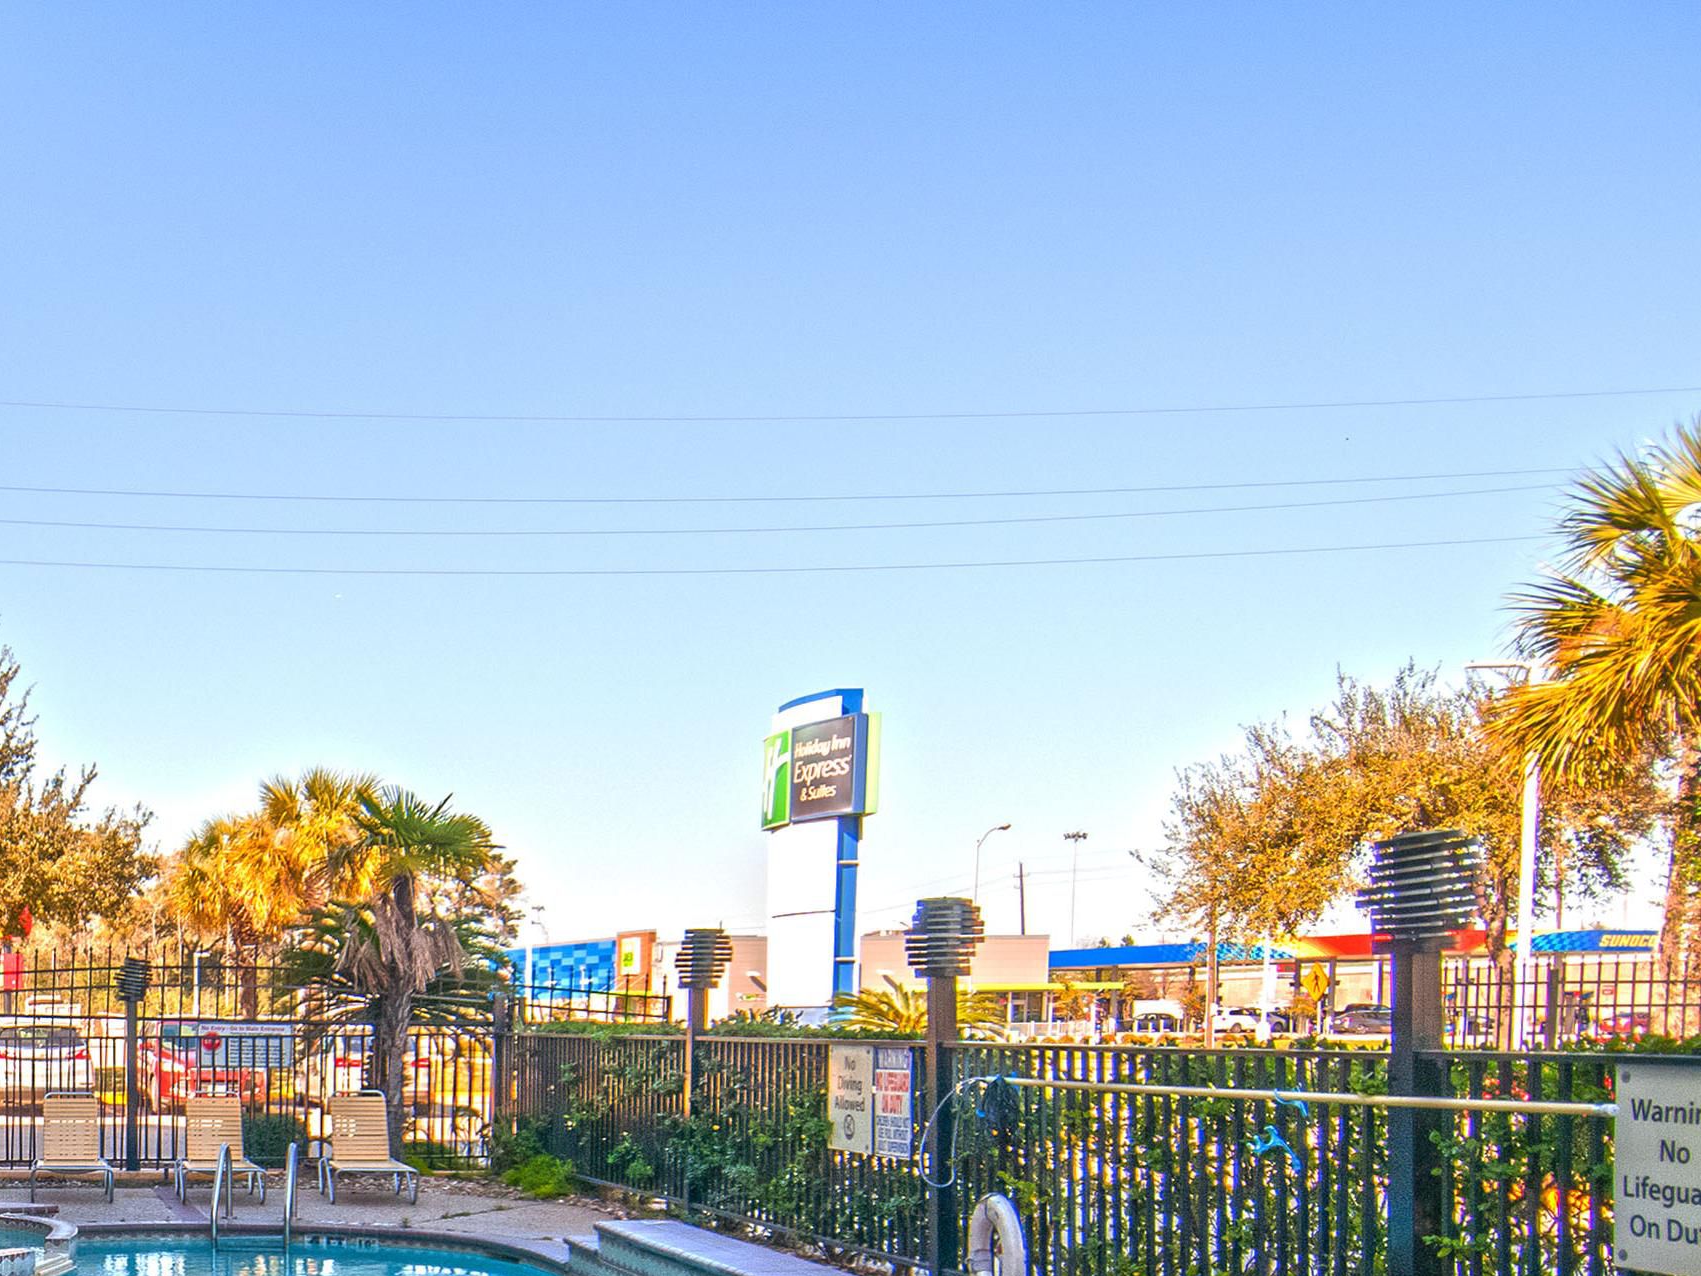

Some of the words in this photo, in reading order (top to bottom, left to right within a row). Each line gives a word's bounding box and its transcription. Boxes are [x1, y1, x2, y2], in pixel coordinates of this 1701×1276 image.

[794, 738, 831, 759] Holiday
[831, 734, 851, 751] Inn
[793, 757, 851, 786] Express
[807, 784, 837, 801] Suites
[845, 1056, 856, 1071] No
[837, 1075, 862, 1095] Diving
[835, 1095, 865, 1112] Allowed
[1660, 1139, 1691, 1164] No
[1630, 1214, 1660, 1240] On
[1667, 1218, 1701, 1245] Du
